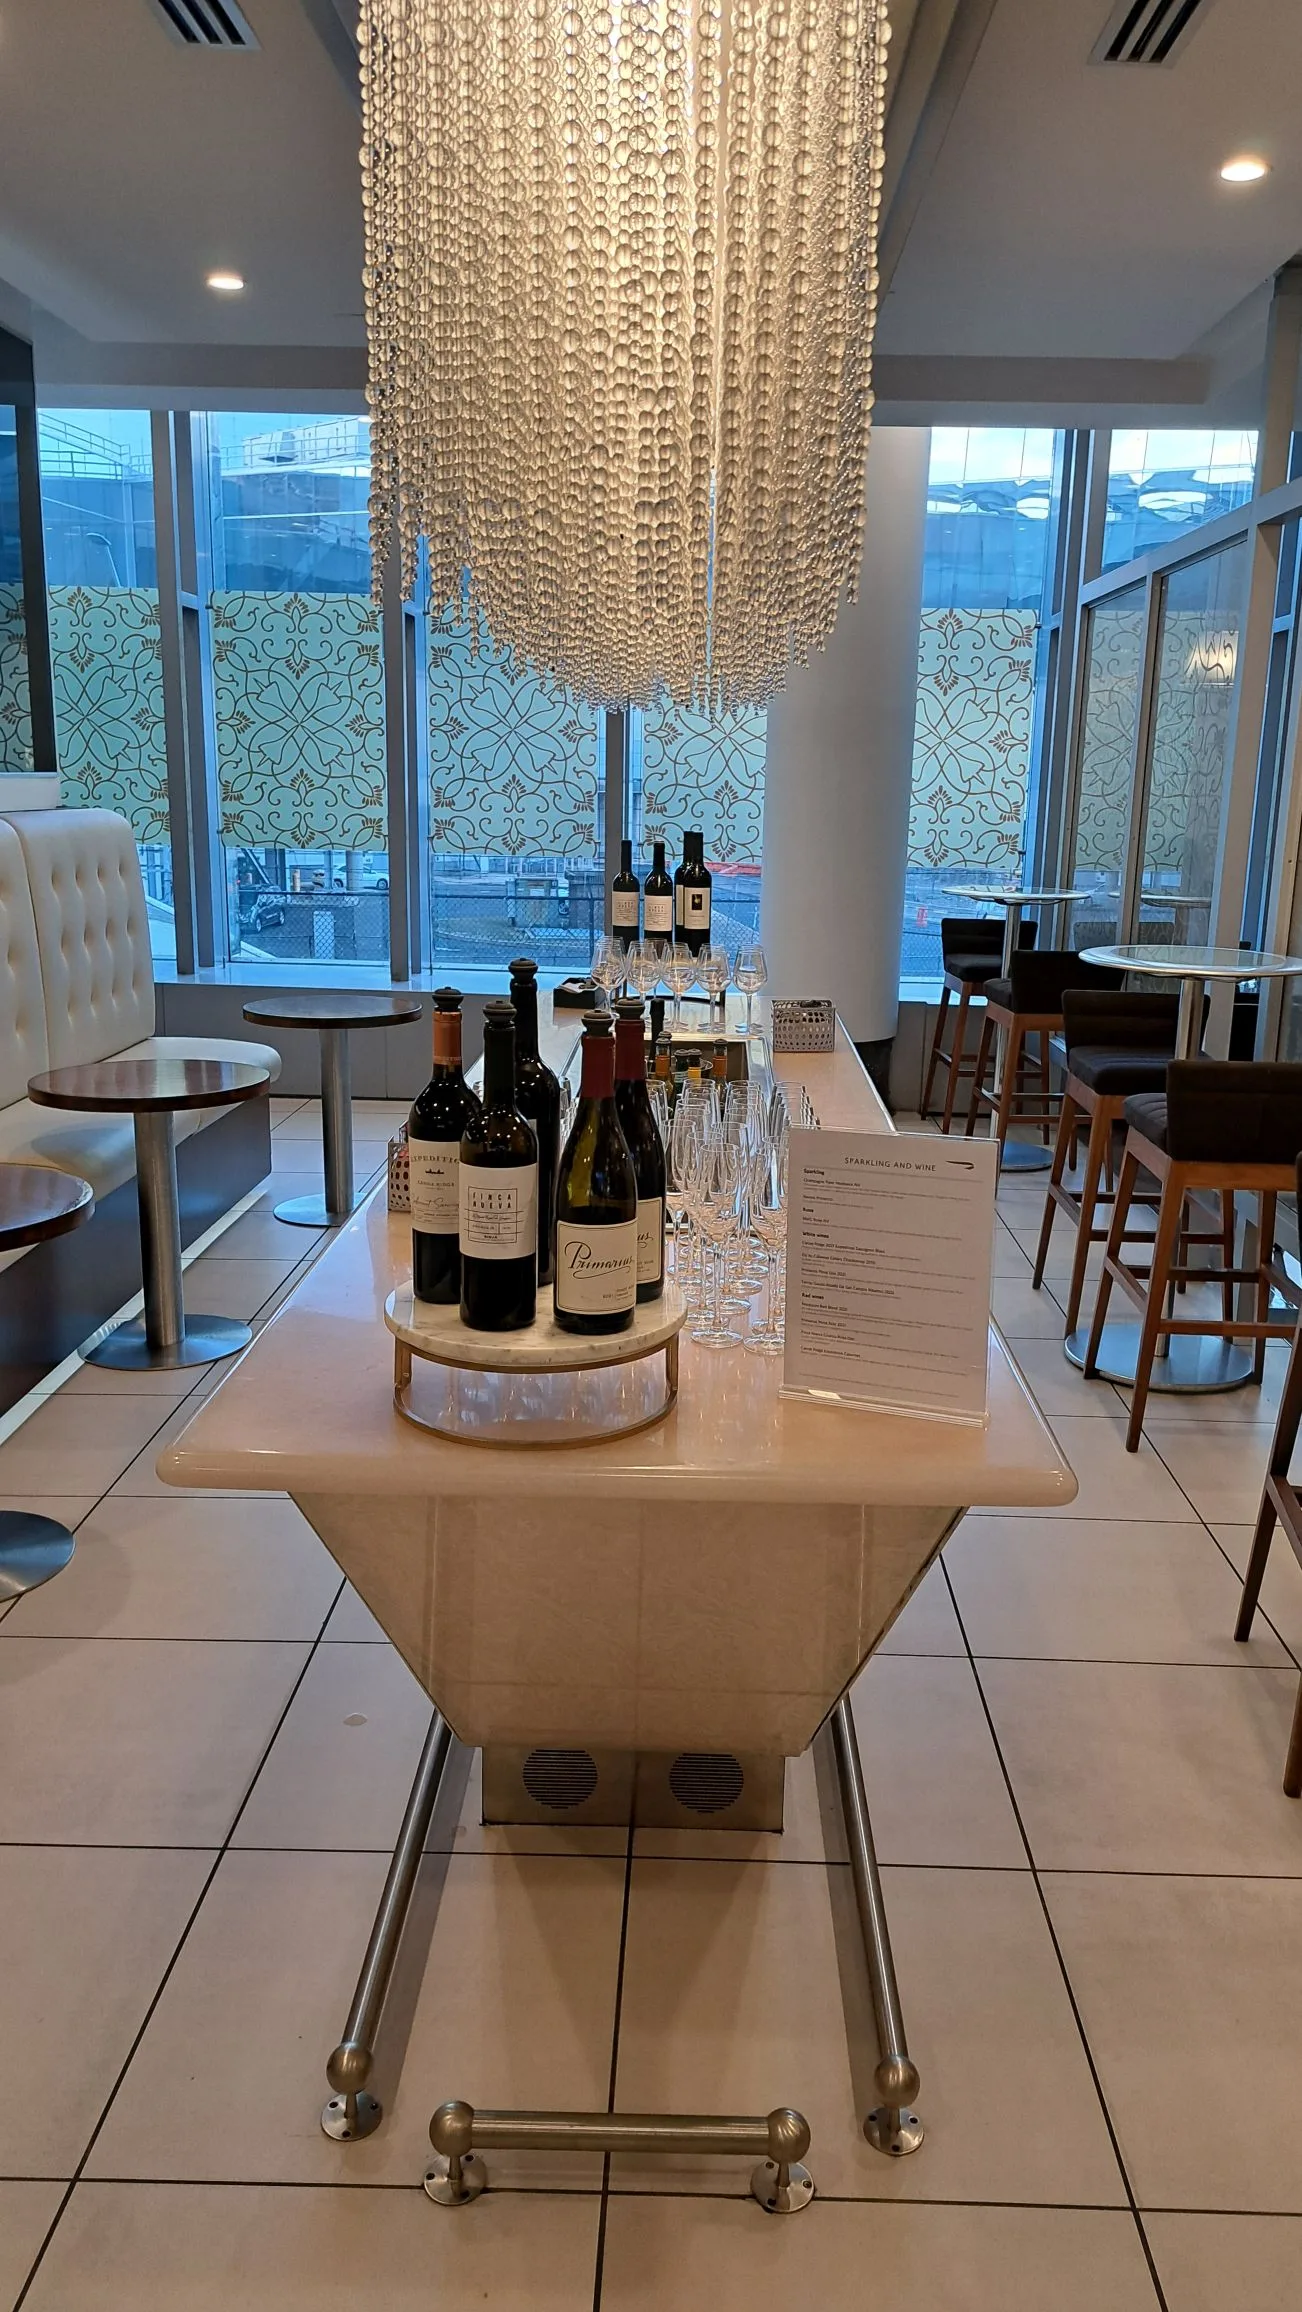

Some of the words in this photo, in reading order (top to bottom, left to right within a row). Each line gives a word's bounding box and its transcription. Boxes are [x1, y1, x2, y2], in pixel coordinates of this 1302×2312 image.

[409, 1155, 460, 1164] EXPEDITIO
[844, 1157, 890, 1168] SPARKLING
[894, 1162, 912, 1170] AND
[915, 1164, 937, 1172] WINE
[803, 1168, 824, 1176] Sparkling
[472, 1192, 511, 1201] FINCA
[472, 1201, 512, 1209] NUEVA
[564, 1241, 634, 1275] Primarius
